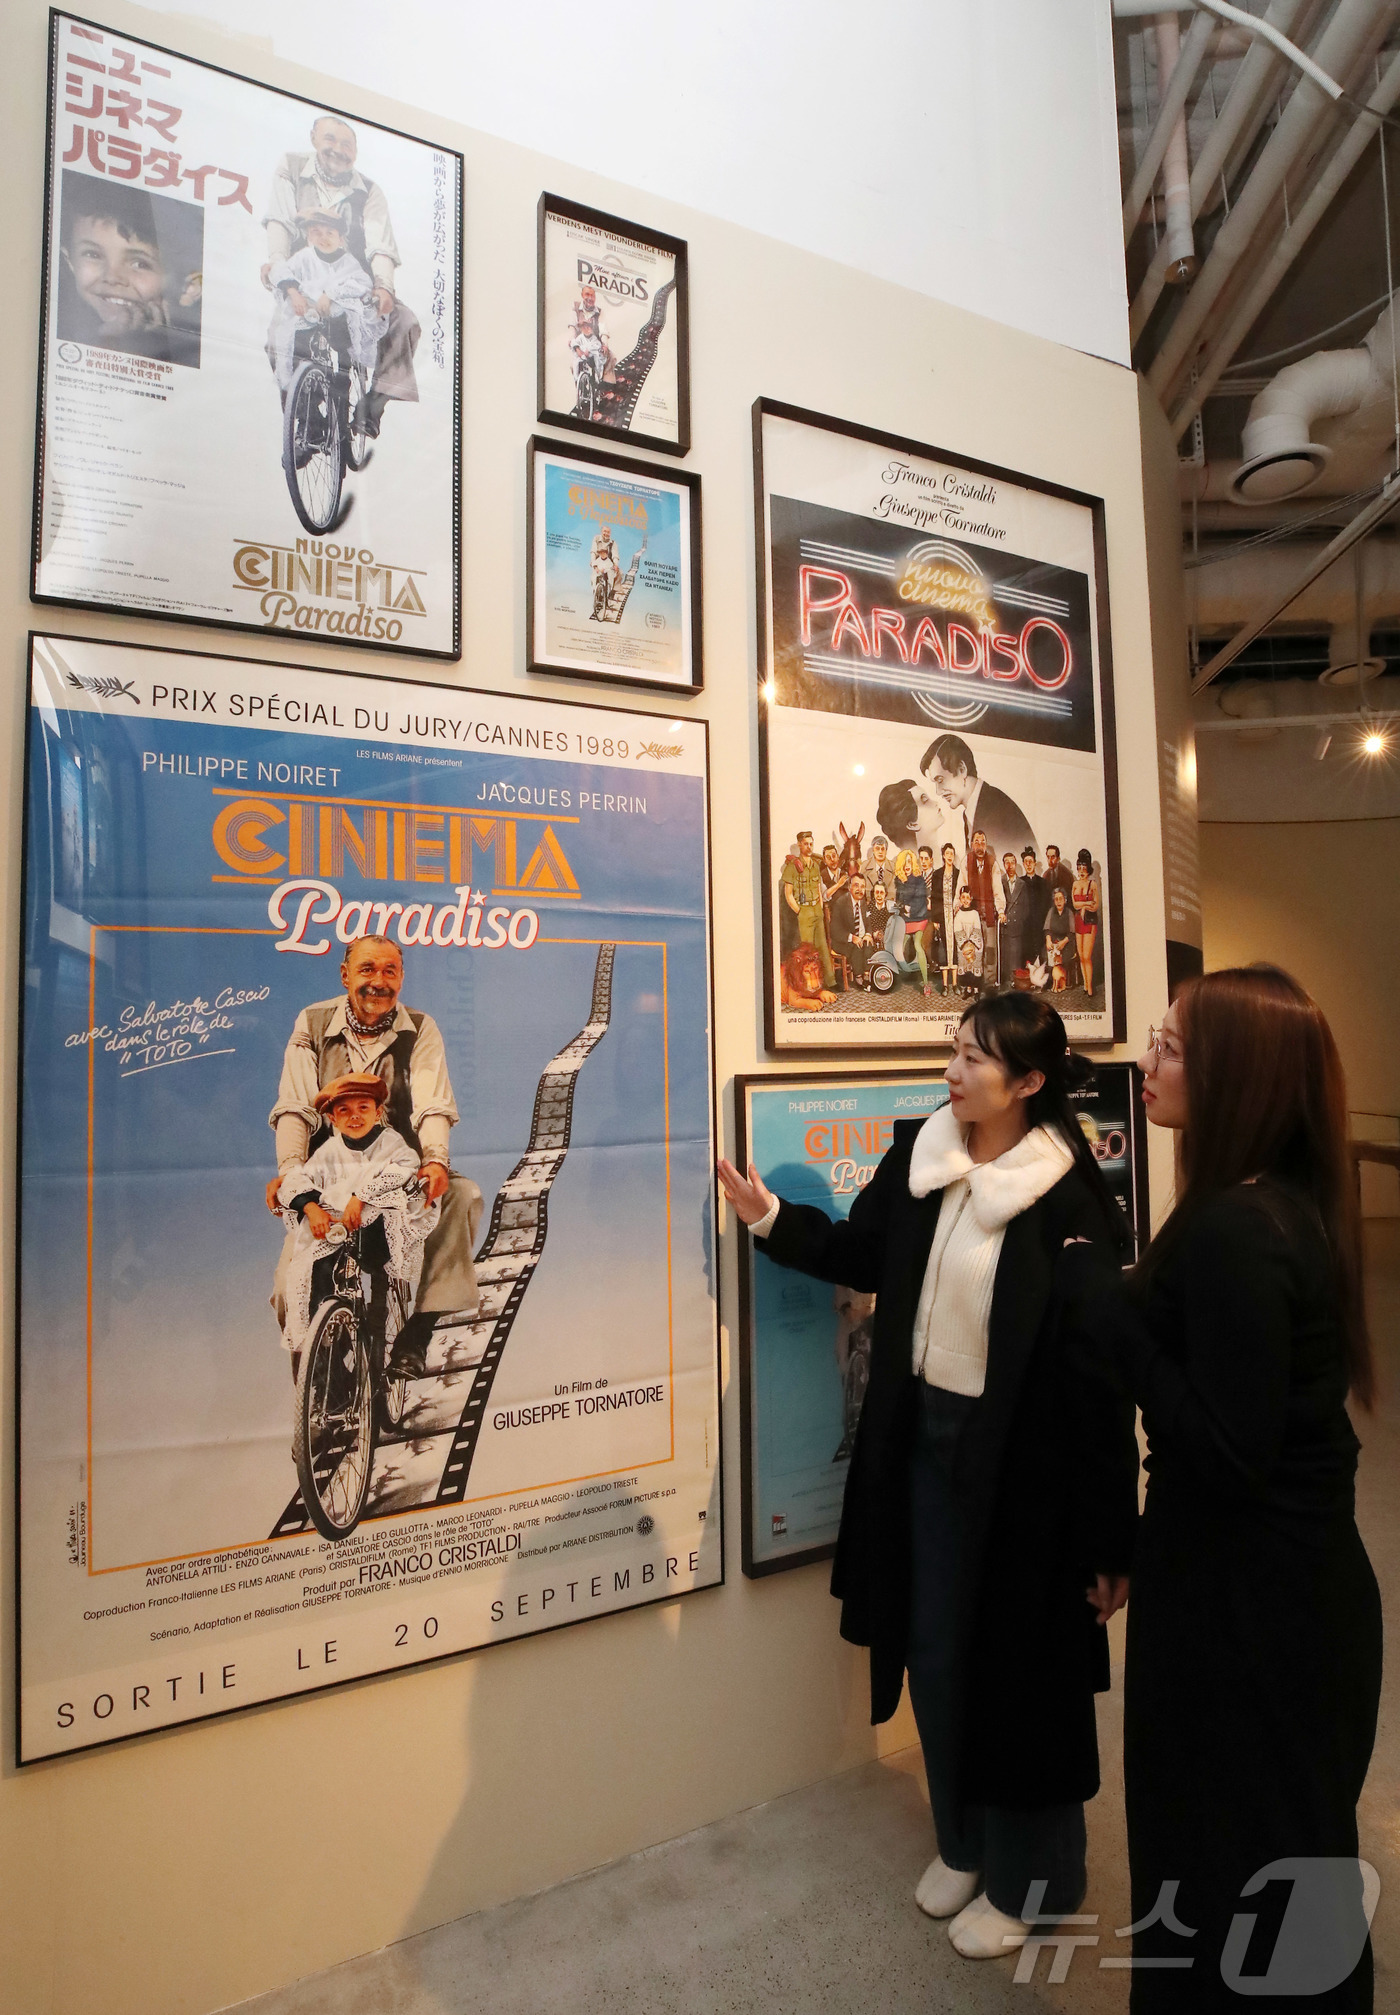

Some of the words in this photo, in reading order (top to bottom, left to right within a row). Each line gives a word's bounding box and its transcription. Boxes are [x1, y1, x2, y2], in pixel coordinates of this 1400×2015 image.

[66, 24, 171, 86] ニュー
[65, 71, 183, 143] シネマ
[62, 124, 253, 215] パラダイス
[547, 213, 581, 230] VERDENS
[583, 225, 602, 236] MEST
[604, 232, 656, 254] VIDUNDERLIGE
[657, 248, 674, 260] FILM
[881, 461, 937, 489] Franco
[943, 473, 997, 504] Cristaldi
[873, 494, 938, 528] Giuseppe
[940, 508, 1006, 541] Tornatore
[296, 537, 375, 565] NUOVO
[233, 545, 427, 614] CINEMA
[260, 591, 404, 642] Paradiso
[799, 564, 1072, 690] PARADISO
[152, 685, 217, 714] PRIX
[229, 693, 345, 727] SPÉCIAL
[354, 708, 390, 732] DU
[399, 714, 569, 752] JURY/CANNES
[576, 734, 630, 759] 1989
[142, 752, 249, 780] PHILIPPE
[257, 761, 342, 788] NOIRET
[356, 749, 371, 759] LES
[371, 751, 394, 762] FILMS
[395, 753, 423, 765] ARIANE
[424, 755, 463, 768] présentent
[477, 782, 572, 809] JACQUES
[579, 791, 647, 814] PERRIN
[212, 799, 581, 890] CINEMA
[268, 879, 540, 955] Paradiso
[64, 1026, 113, 1048] avec
[118, 997, 217, 1033] Salvatore
[215, 985, 270, 1010] Cascio
[105, 1032, 153, 1052] dans
[155, 1024, 171, 1042] le
[172, 1017, 209, 1038] rôle
[209, 1013, 234, 1030] de
[789, 1101, 825, 1113] PHILIPPE
[825, 1099, 858, 1112] NOIRET
[893, 1095, 935, 1108] JACQUES
[493, 1402, 570, 1431] GIUSEPPE
[575, 1385, 664, 1416] TORNATORE
[554, 1384, 569, 1396] Un
[571, 1380, 592, 1393] Film
[595, 1378, 608, 1389] de
[83, 1601, 146, 1621] Coproduction
[148, 1586, 219, 1608] Franco-Italienne
[220, 1582, 236, 1594] LES
[238, 1577, 263, 1590] FILMS
[264, 1570, 296, 1585] ARIANE
[298, 1564, 327, 1580] (Paris)
[329, 1552, 386, 1571] CRISTALDIFILM
[388, 1544, 417, 1560] (Rome)
[420, 1541, 432, 1551] TF1
[434, 1536, 456, 1549] FILMS
[457, 1525, 506, 1543] PRODUCTION
[512, 1517, 541, 1531] RAI/TRE
[544, 1510, 581, 1524] Producteur
[582, 1504, 608, 1516] Associé
[609, 1497, 633, 1510] FORUM
[633, 1490, 660, 1504] PICTURE
[145, 1569, 200, 1587] ANTONELLA
[235, 1557, 259, 1570] ENZO
[261, 1547, 310, 1565] CANNAVALE
[318, 1542, 332, 1553] ISA
[372, 1530, 387, 1542] LEO
[389, 1523, 430, 1538] GULLOTTA
[436, 1514, 465, 1528] MARCO
[466, 1507, 503, 1522] LEONARDI
[509, 1499, 540, 1513] PUPELLA
[541, 1492, 570, 1505] MAGGIO
[576, 1483, 612, 1498] LEOPOLDO
[613, 1477, 639, 1489] TRIESTE
[326, 1553, 334, 1561] et
[336, 1543, 381, 1559] SALVATORE
[382, 1535, 411, 1549] CASCIO
[413, 1532, 433, 1542] dans
[434, 1529, 441, 1538] le
[442, 1526, 457, 1537] rôle
[458, 1523, 468, 1533] de
[145, 1564, 168, 1577] Avec
[170, 1561, 186, 1574] par
[188, 1557, 212, 1569] ordre
[303, 1579, 338, 1597] Produit
[339, 1577, 356, 1591] par
[359, 1552, 433, 1584] FRANCO
[438, 1533, 521, 1567] CRISTALDI
[517, 1547, 548, 1560] Distribué
[549, 1543, 561, 1554] par
[562, 1535, 588, 1549] ARIANE
[588, 1526, 634, 1544] DISTRIBUTION
[150, 1625, 191, 1642] Scénario,
[193, 1613, 242, 1632] Adaptation
[243, 1612, 252, 1621] et
[254, 1601, 300, 1618] Réalisation
[302, 1591, 342, 1608] GIUSEPPE
[344, 1581, 391, 1599] TORNATORE
[398, 1572, 431, 1587] Musique
[432, 1565, 463, 1579] d'ENNIO
[464, 1554, 509, 1572] MORRICONE
[57, 1664, 236, 1728] SORTIE
[297, 1640, 338, 1671] LE
[394, 1616, 439, 1647] 20
[490, 1551, 699, 1623] SEPTEMBRE
